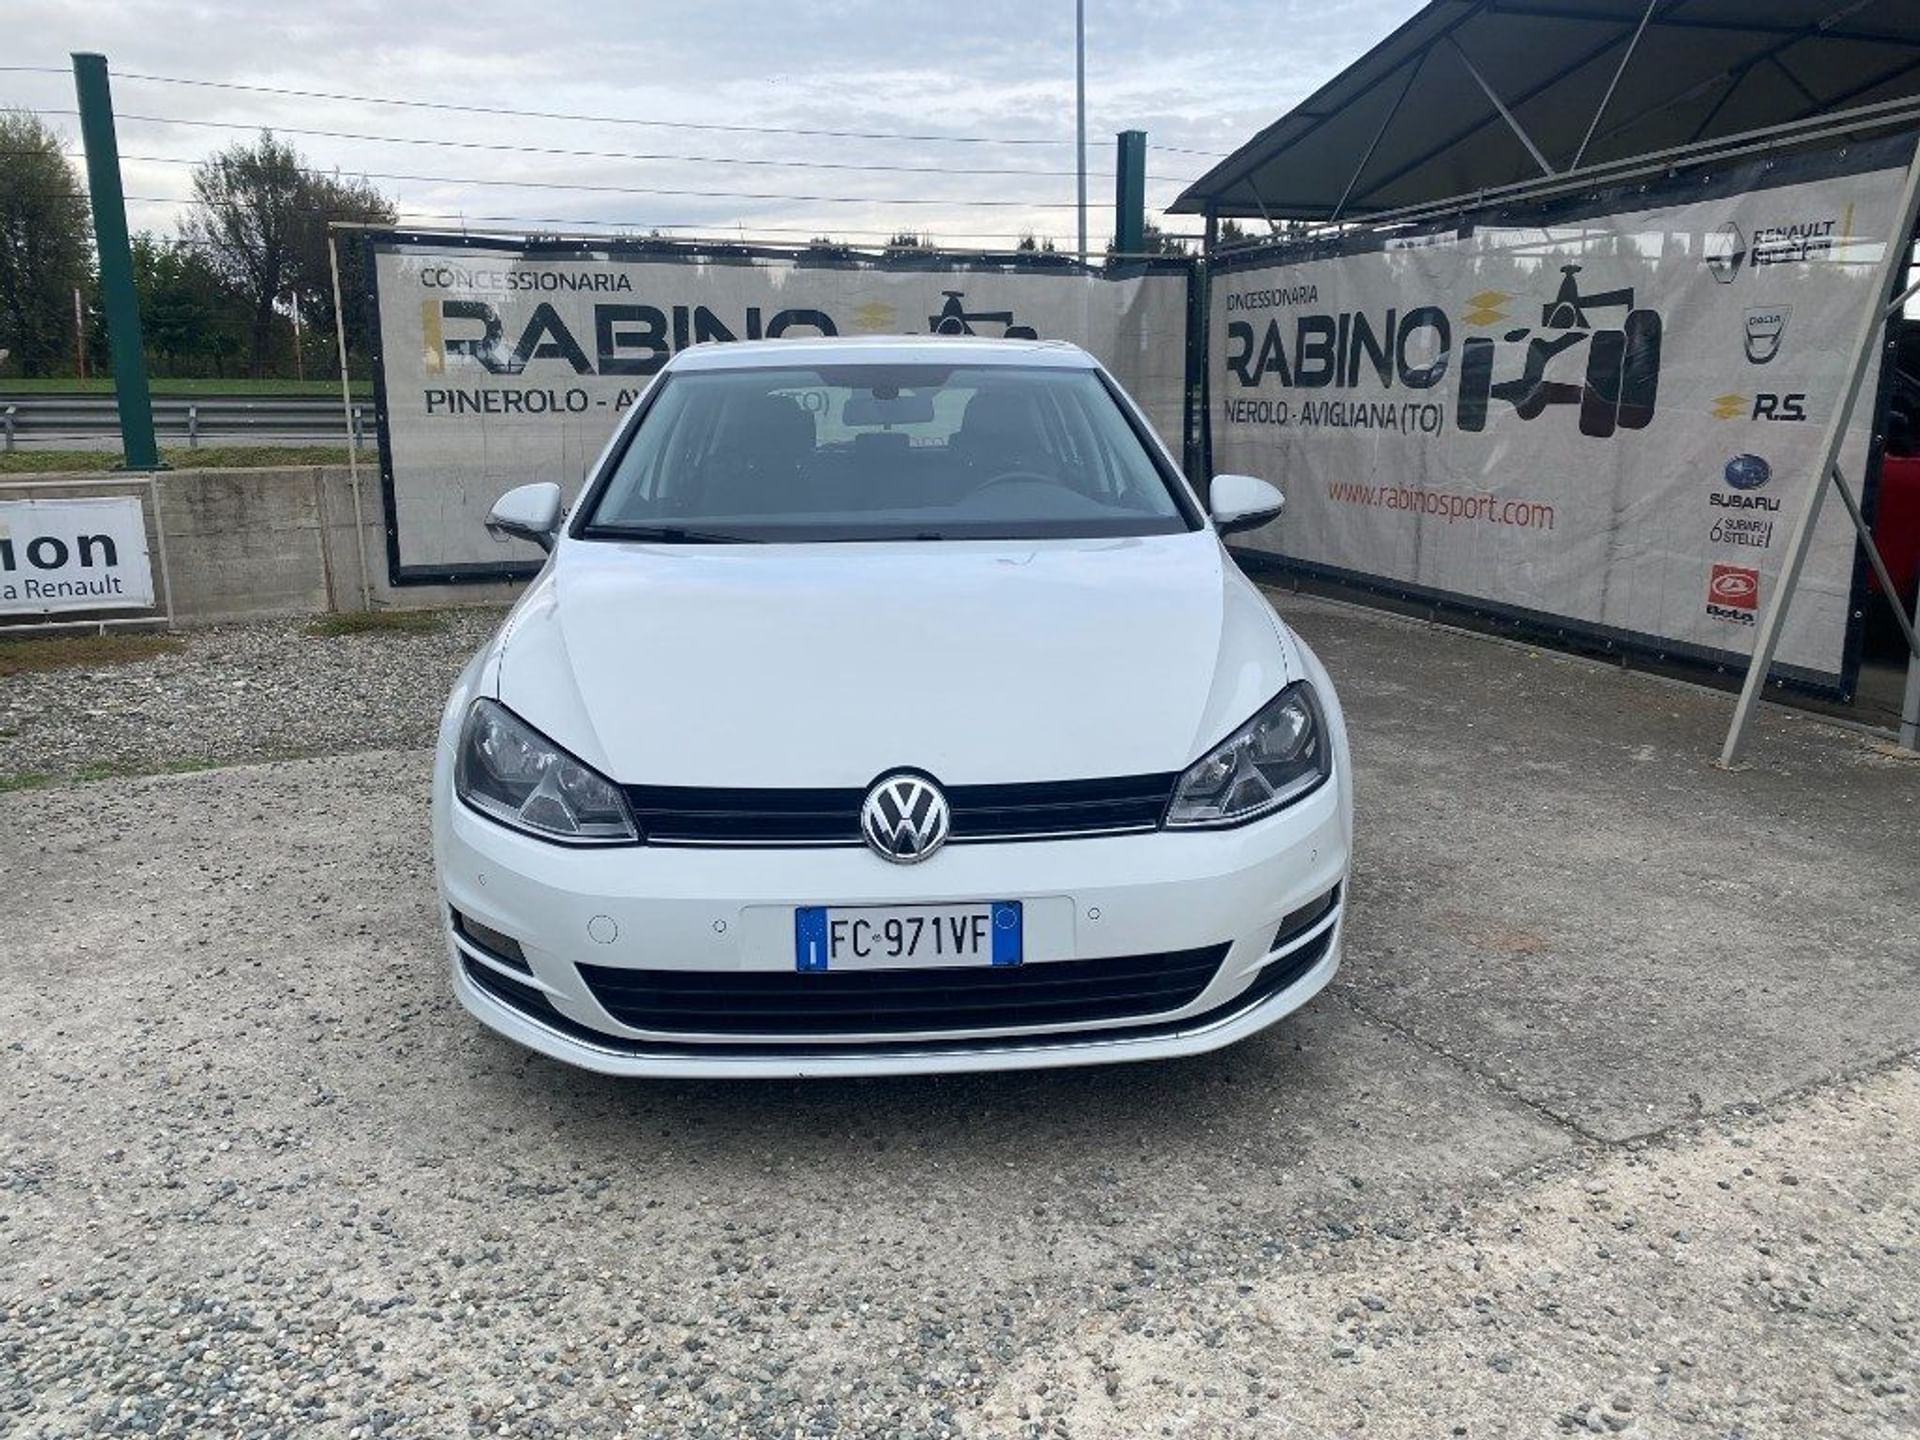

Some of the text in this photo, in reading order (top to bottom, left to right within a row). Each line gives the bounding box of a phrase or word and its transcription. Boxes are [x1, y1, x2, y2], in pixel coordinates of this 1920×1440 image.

[1752, 221, 1836, 245] RENAULT
[420, 267, 633, 292] CONCESSIONARIA
[1227, 306, 1452, 389] RABINO
[424, 388, 589, 414] PINEROLO
[1299, 401, 1398, 430] AVIGLIANA
[1401, 401, 1445, 438] (TO)
[1329, 480, 1555, 530] www.rabinosport.com
[1709, 492, 1781, 511] SUBARU
[1724, 519, 1768, 533] SUBARU
[1723, 531, 1764, 547] STELLE
[25, 574, 123, 599] Renault
